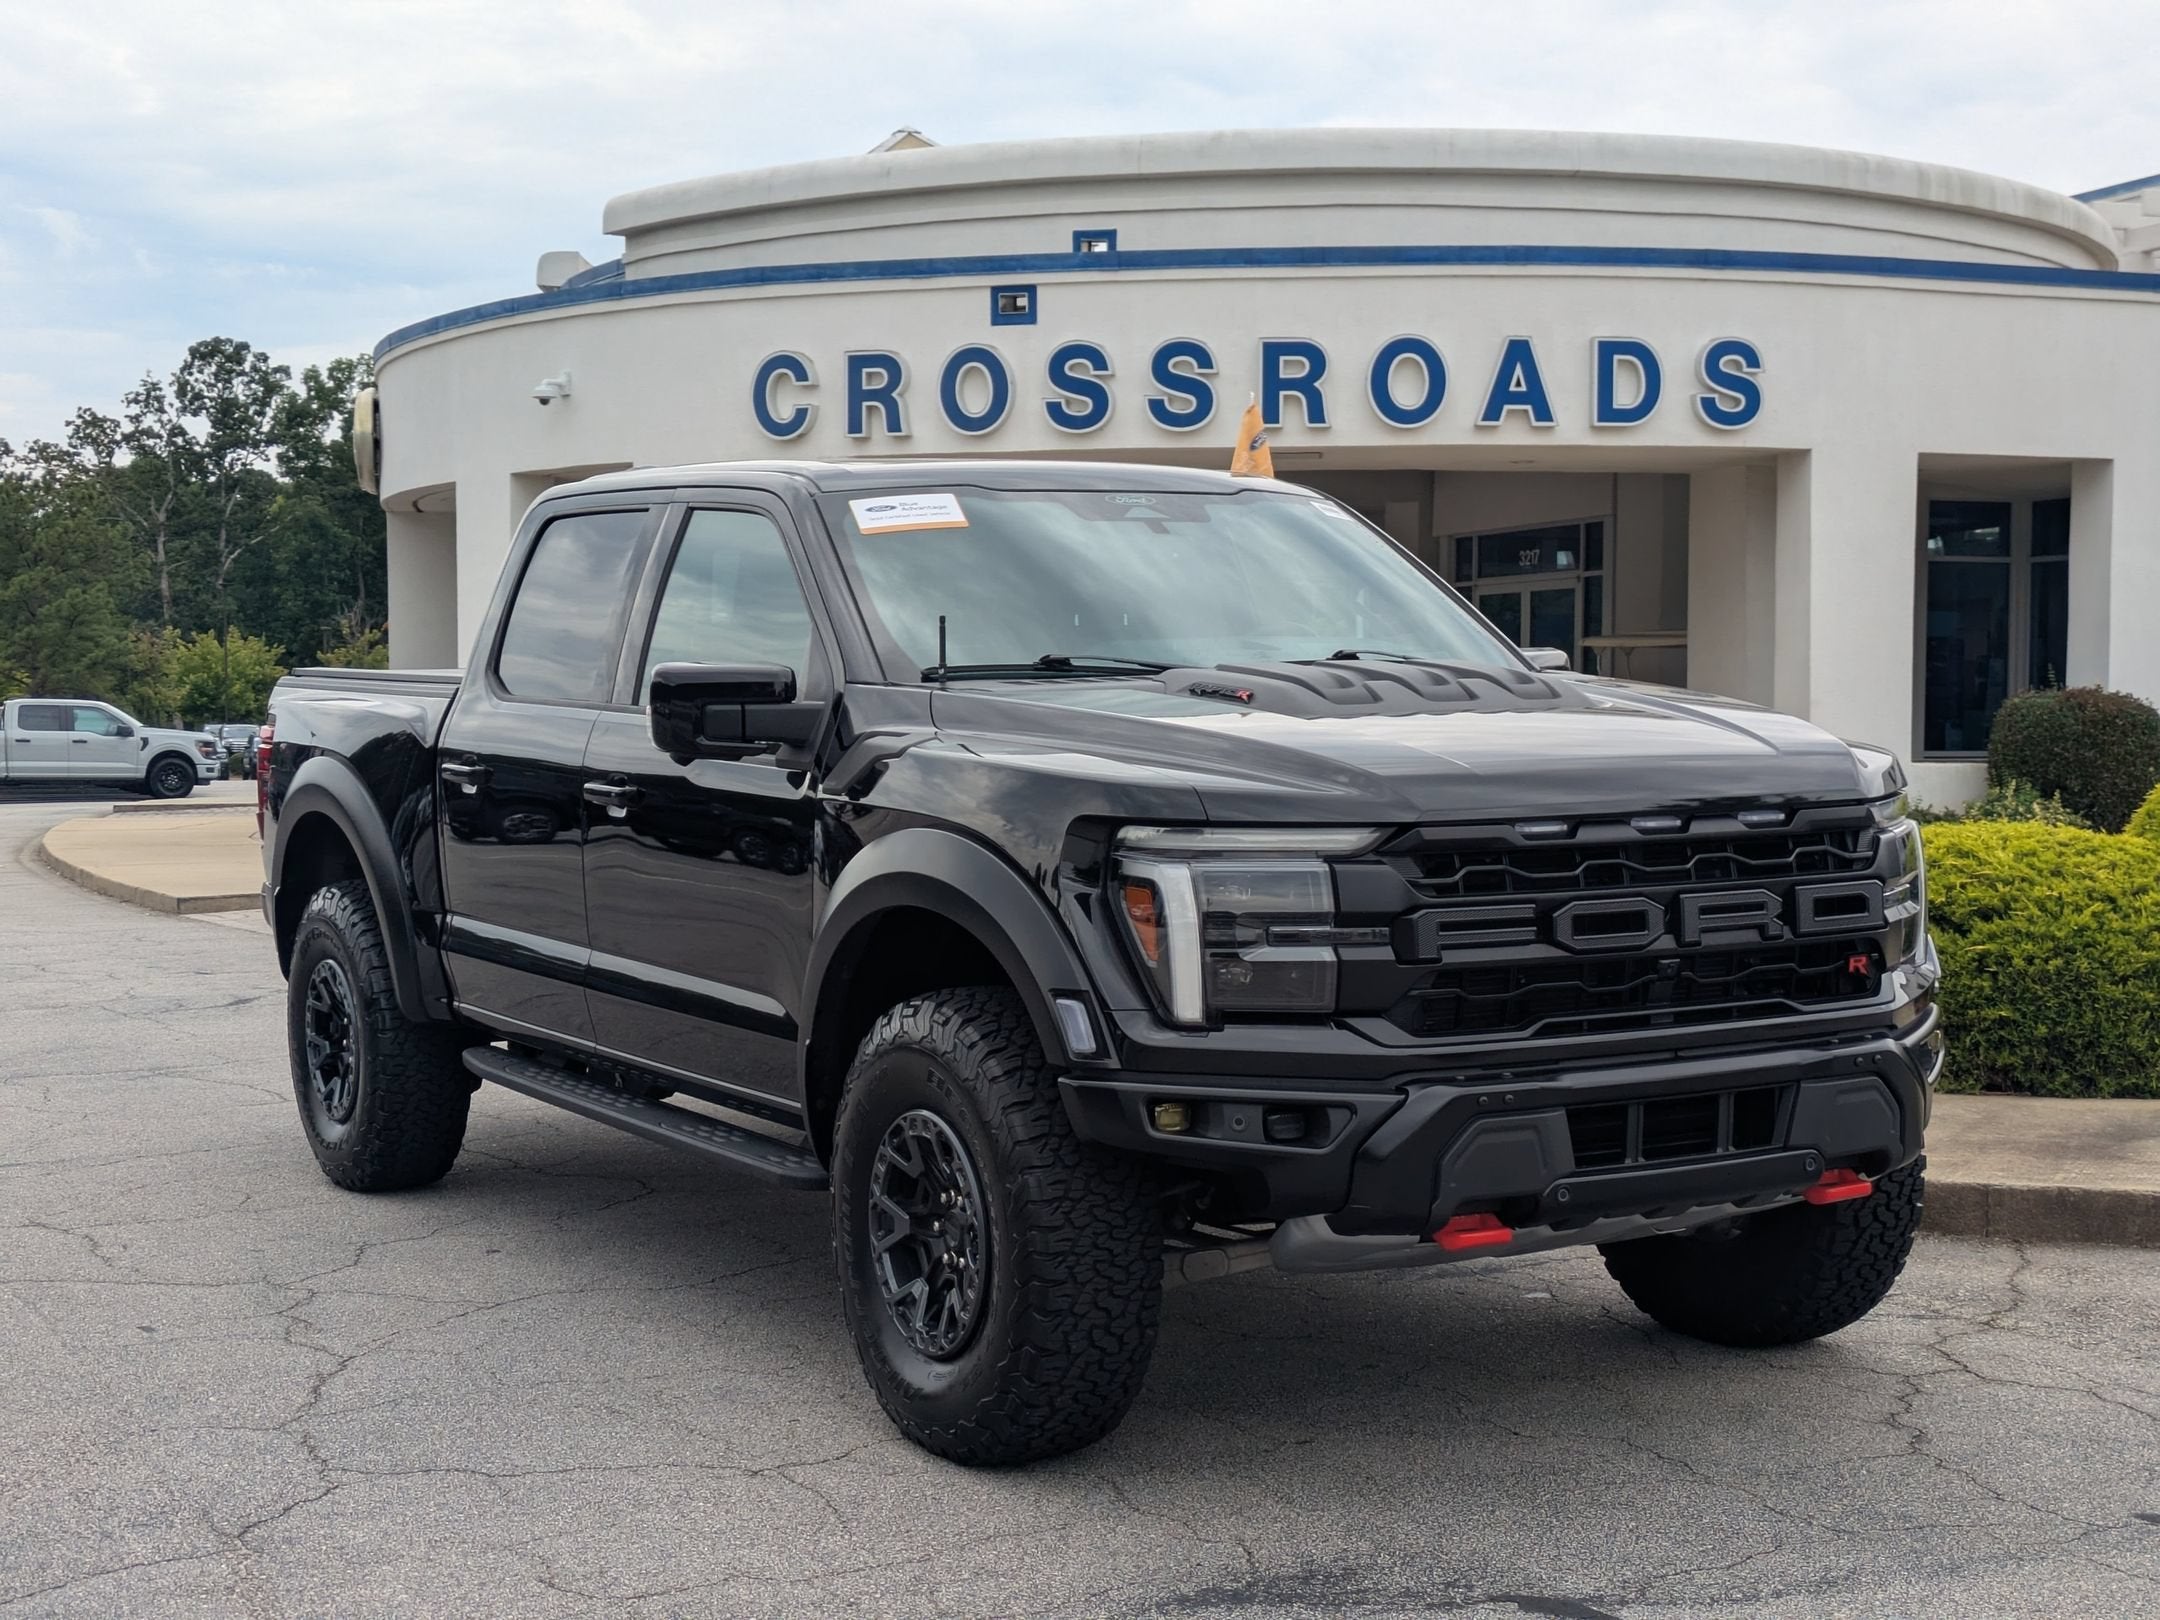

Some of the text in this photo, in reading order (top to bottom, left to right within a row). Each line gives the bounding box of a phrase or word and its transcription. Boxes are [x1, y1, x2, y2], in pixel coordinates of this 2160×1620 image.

[752, 333, 1764, 440] CROSSROADS
[1519, 549, 1540, 566] 3217
[1402, 880, 1887, 965] FORD
[1848, 956, 1868, 975] R
